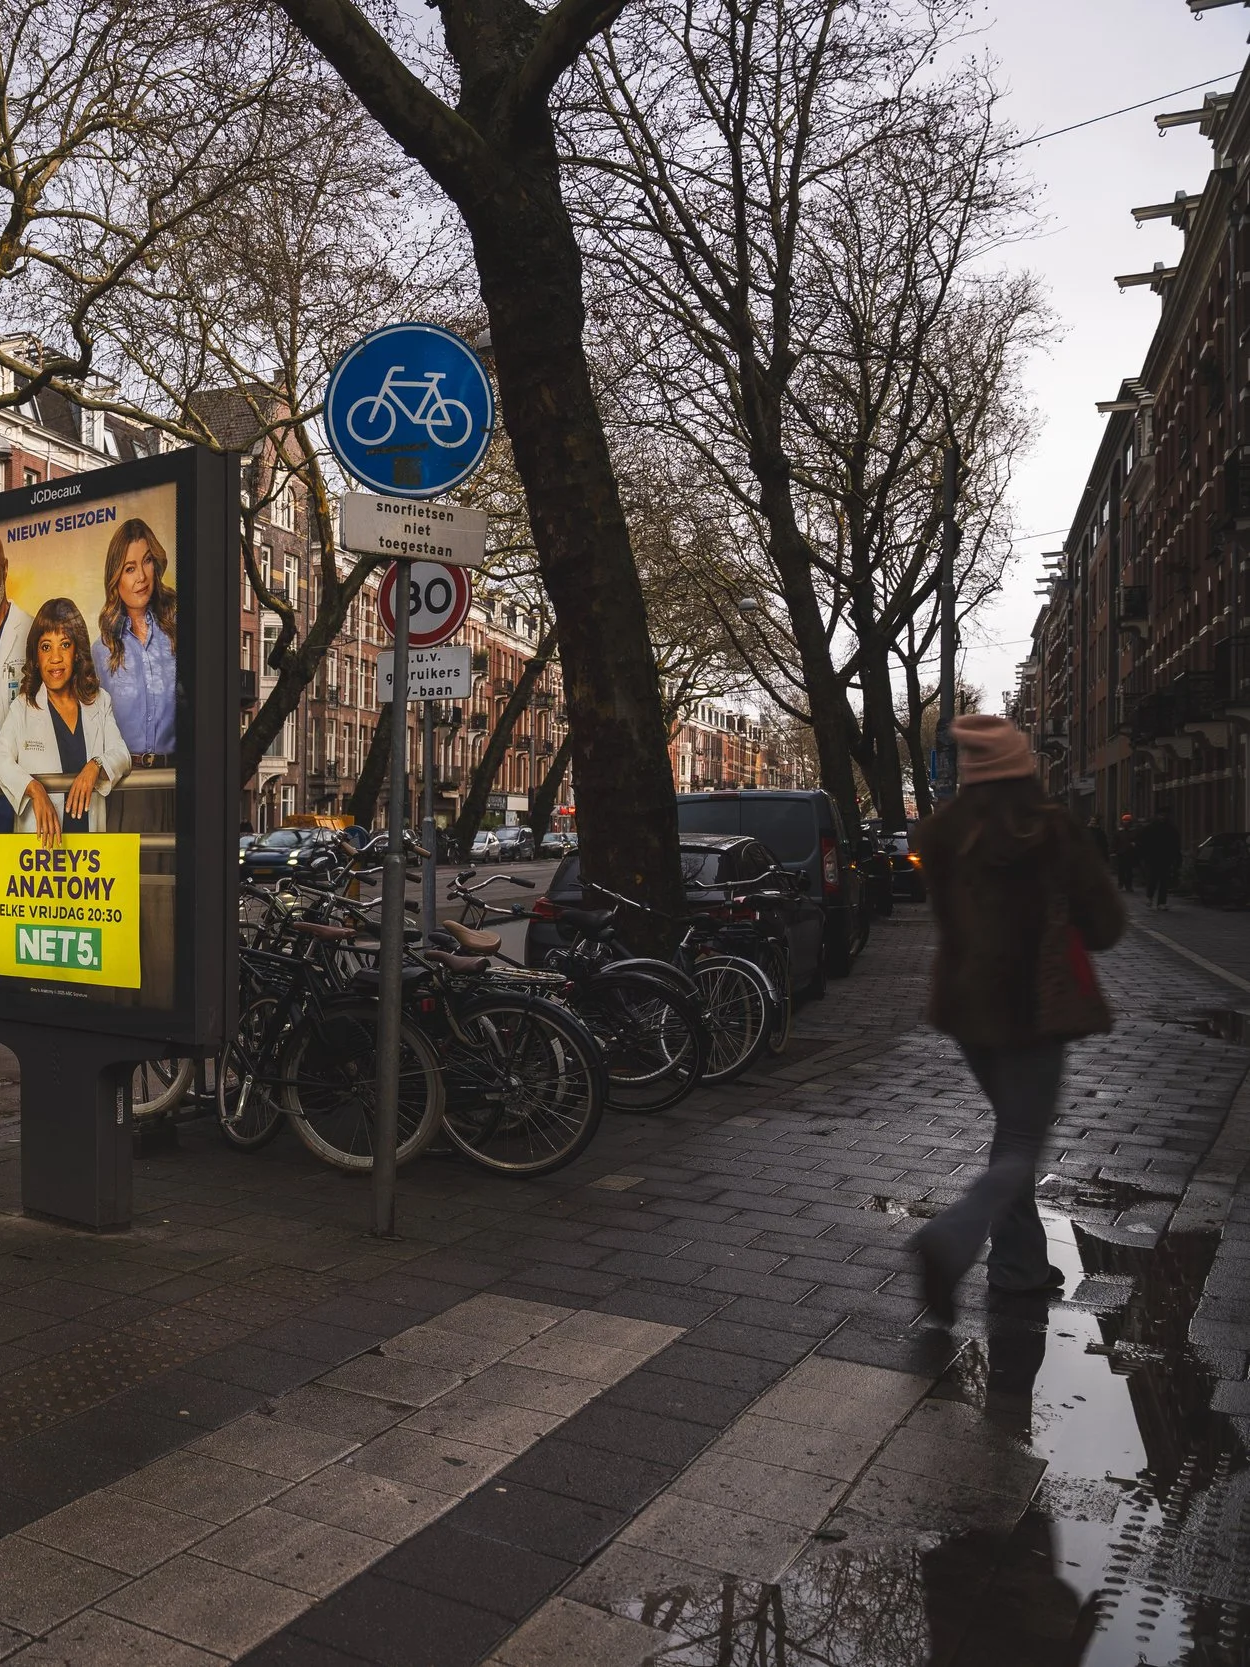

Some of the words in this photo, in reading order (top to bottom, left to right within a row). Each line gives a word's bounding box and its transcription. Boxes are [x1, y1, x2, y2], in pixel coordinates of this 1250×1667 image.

[30, 484, 82, 505] JCDecaux
[376, 502, 454, 522] snorfietsen
[7, 520, 51, 543] NIEUW
[55, 506, 117, 533] SEIZOEN
[404, 522, 431, 536] niet
[379, 536, 452, 557] toegestaan
[407, 652, 441, 664] .u.v.
[19, 849, 100, 873] GREY'S
[6, 875, 115, 900] ANATOMY
[0, 904, 26, 917] ELKE
[29, 905, 85, 920] VRIJDAG
[87, 908, 123, 923] 20:30
